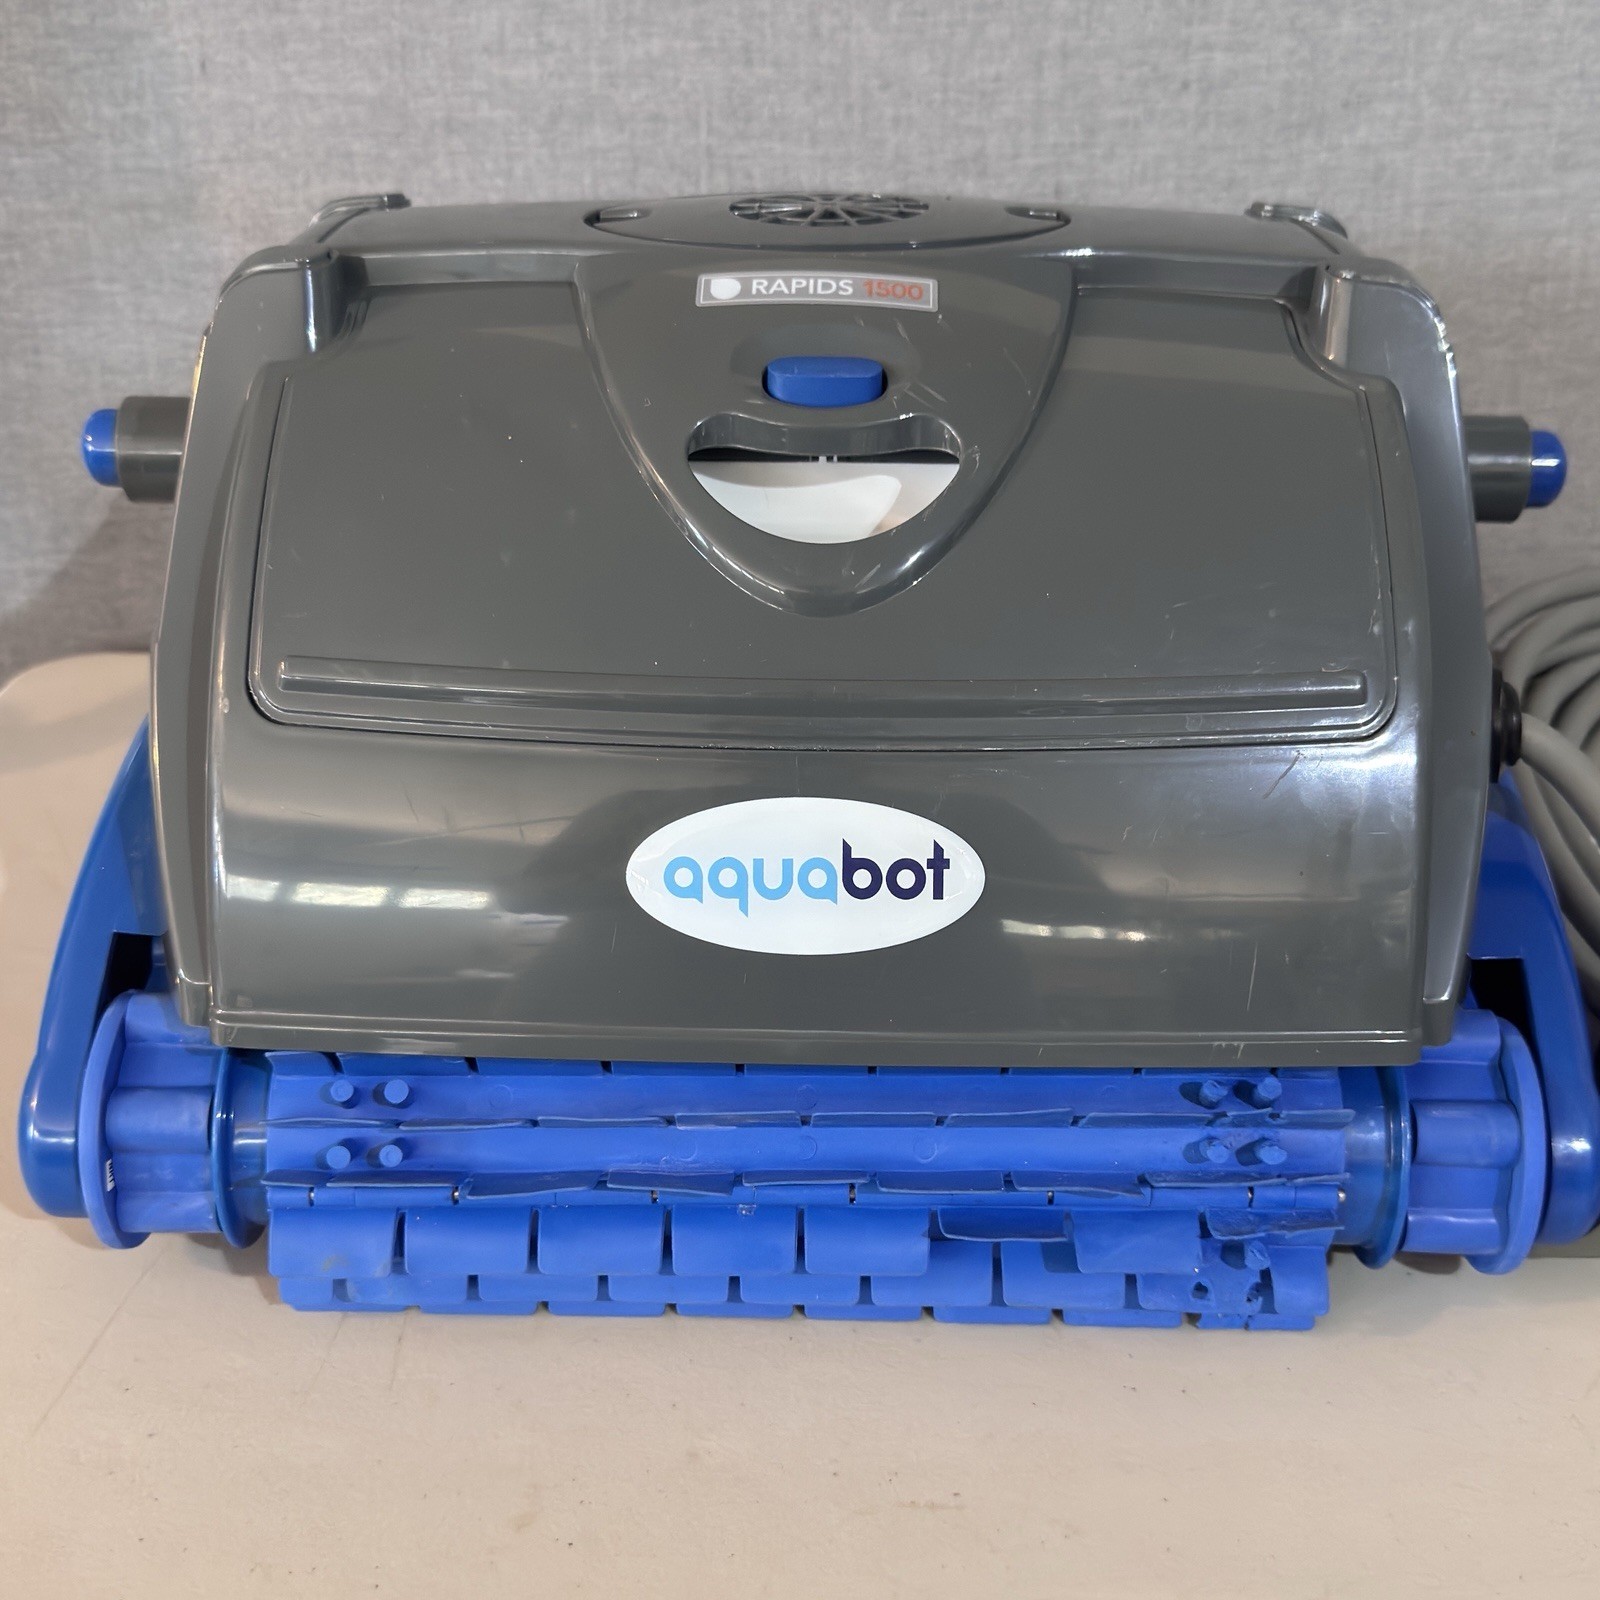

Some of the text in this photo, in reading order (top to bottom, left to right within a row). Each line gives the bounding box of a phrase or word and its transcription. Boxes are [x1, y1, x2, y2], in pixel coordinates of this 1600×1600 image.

[751, 278, 924, 300] RAPIDS 1500
[663, 837, 951, 918] aquabot
